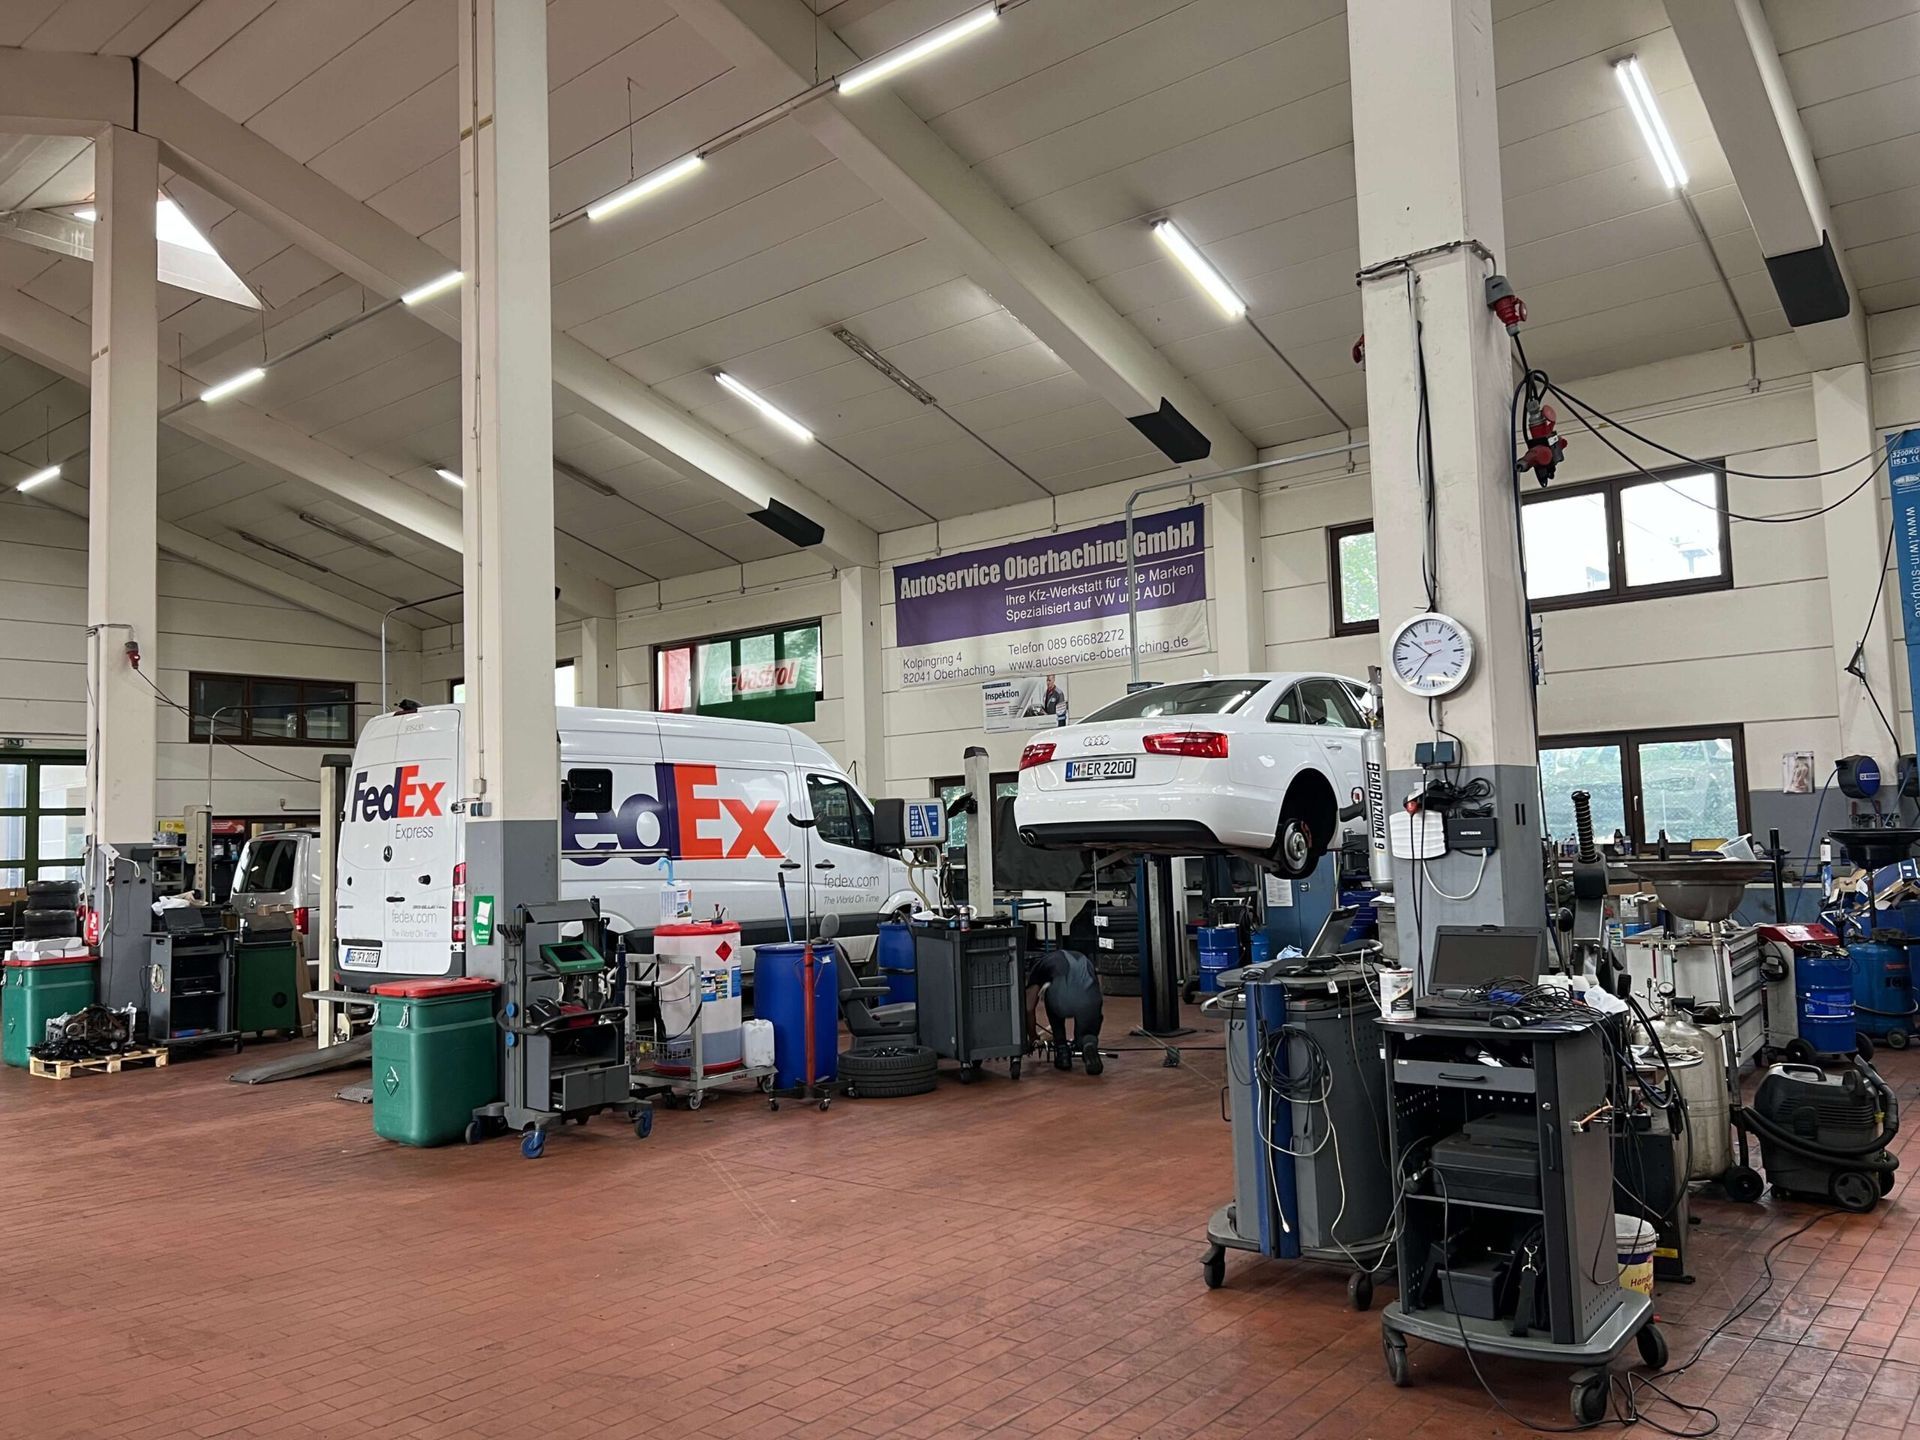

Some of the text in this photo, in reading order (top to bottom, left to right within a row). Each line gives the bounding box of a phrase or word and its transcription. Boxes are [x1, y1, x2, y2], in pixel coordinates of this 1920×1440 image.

[1893, 457, 1908, 465] ISO
[900, 520, 1195, 600] Autoservice Oberhaching GmbH
[1006, 564, 1194, 606] Ihre Kfz-Werkstatt für ale Marken
[1006, 601, 1071, 623] Spezialisiert
[1074, 597, 1092, 611] auf
[1094, 593, 1115, 607] VW
[1143, 582, 1175, 599] AUDI
[1008, 628, 1125, 655] Telefon 089 66682272
[1009, 636, 1189, 671] www.autoservice-oberhching.de
[904, 652, 963, 670] Kolpingring 4
[736, 661, 796, 692] Castrol
[904, 663, 996, 684] 82041 Oberhaching
[985, 689, 1020, 701] Inspektion
[1073, 761, 1132, 776] M ER 2200
[350, 764, 446, 823] FedEx
[1366, 761, 1386, 850] BEADBAZOOKA 9
[560, 762, 787, 867] edEx
[395, 823, 434, 840] Express
[824, 873, 880, 889] fedex.com
[824, 894, 880, 905] The World On Time
[391, 910, 438, 924] fedex.com
